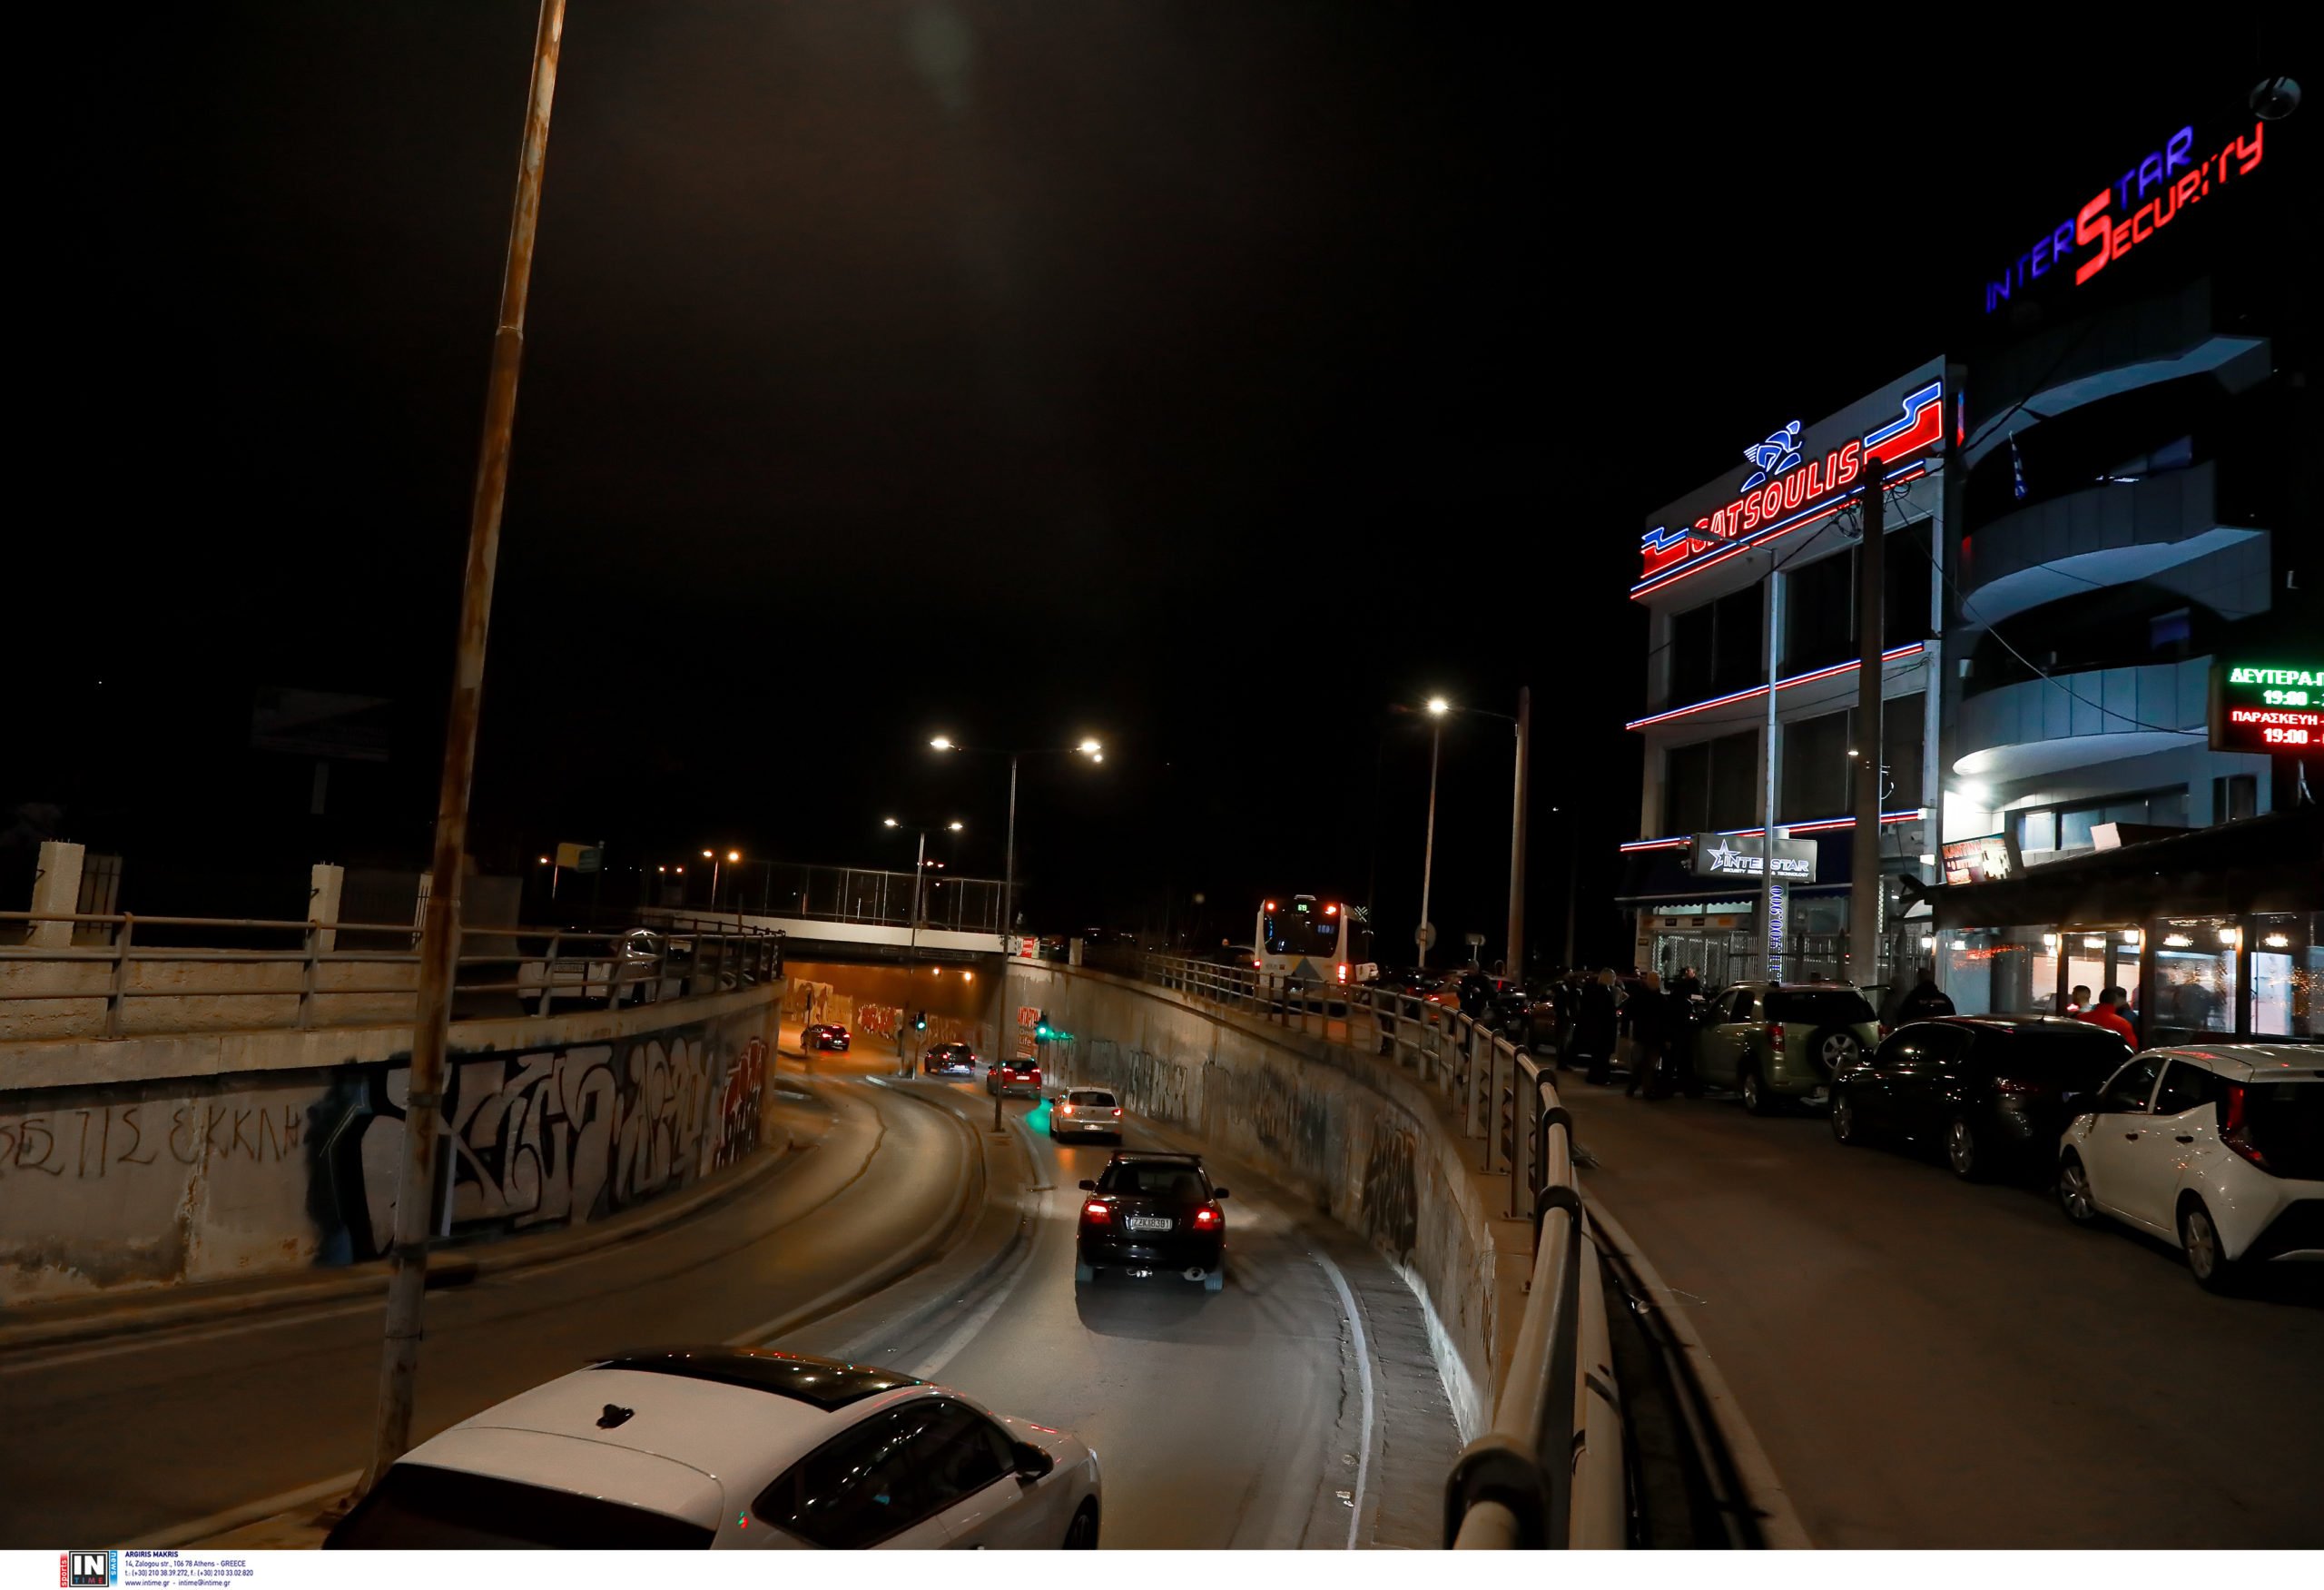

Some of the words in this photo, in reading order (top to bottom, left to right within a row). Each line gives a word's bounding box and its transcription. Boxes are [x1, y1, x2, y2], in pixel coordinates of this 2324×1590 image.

[2075, 121, 2263, 286] SECURITY
[2232, 711, 2318, 726] ΠΑΡΑΣΚΕΥΗ
[2263, 728, 2309, 744] 19:00
[1723, 855, 1810, 872] INTESTAR
